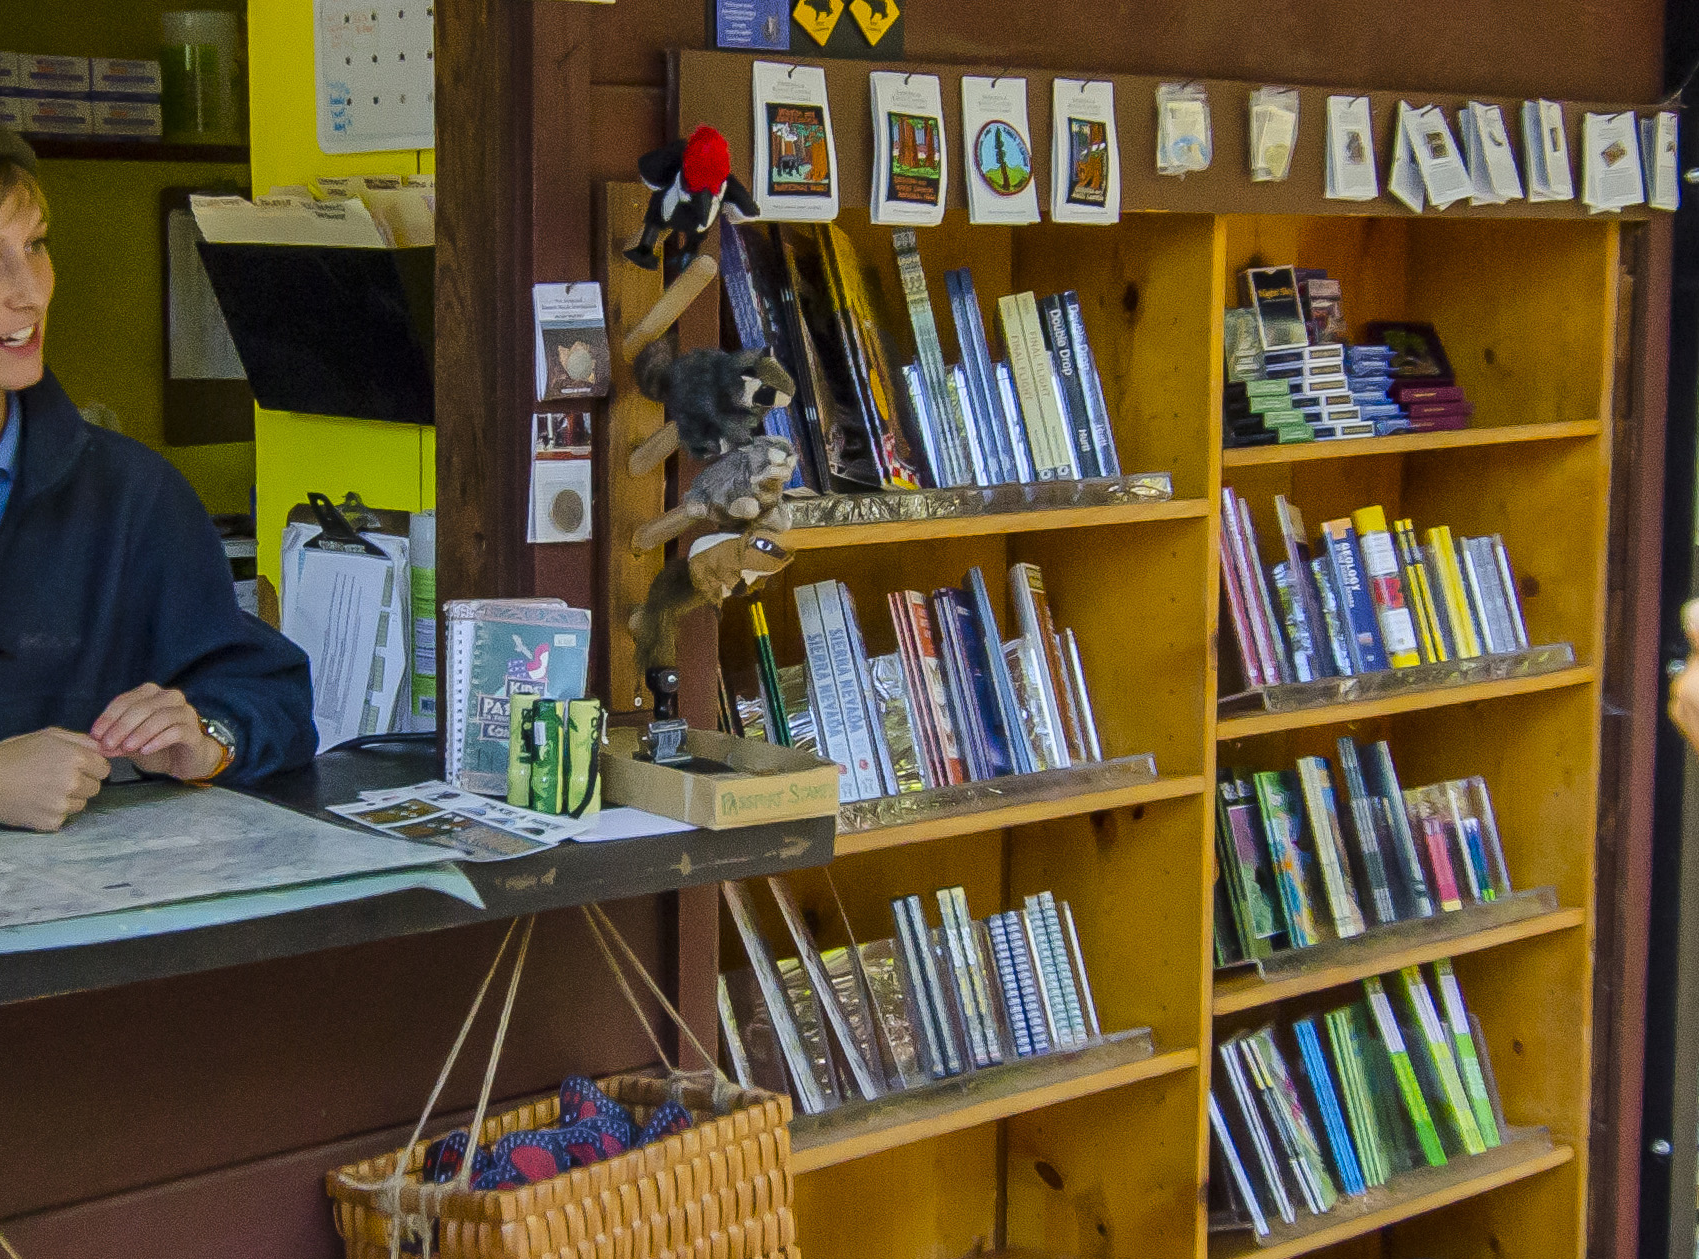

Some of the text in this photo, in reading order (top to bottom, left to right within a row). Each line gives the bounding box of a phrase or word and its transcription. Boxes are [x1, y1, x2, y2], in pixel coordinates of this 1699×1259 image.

[1058, 348, 1074, 376] Drop
[807, 631, 844, 739] SIERRA NEVADA
[829, 627, 865, 734] SIERRA NEVADA
